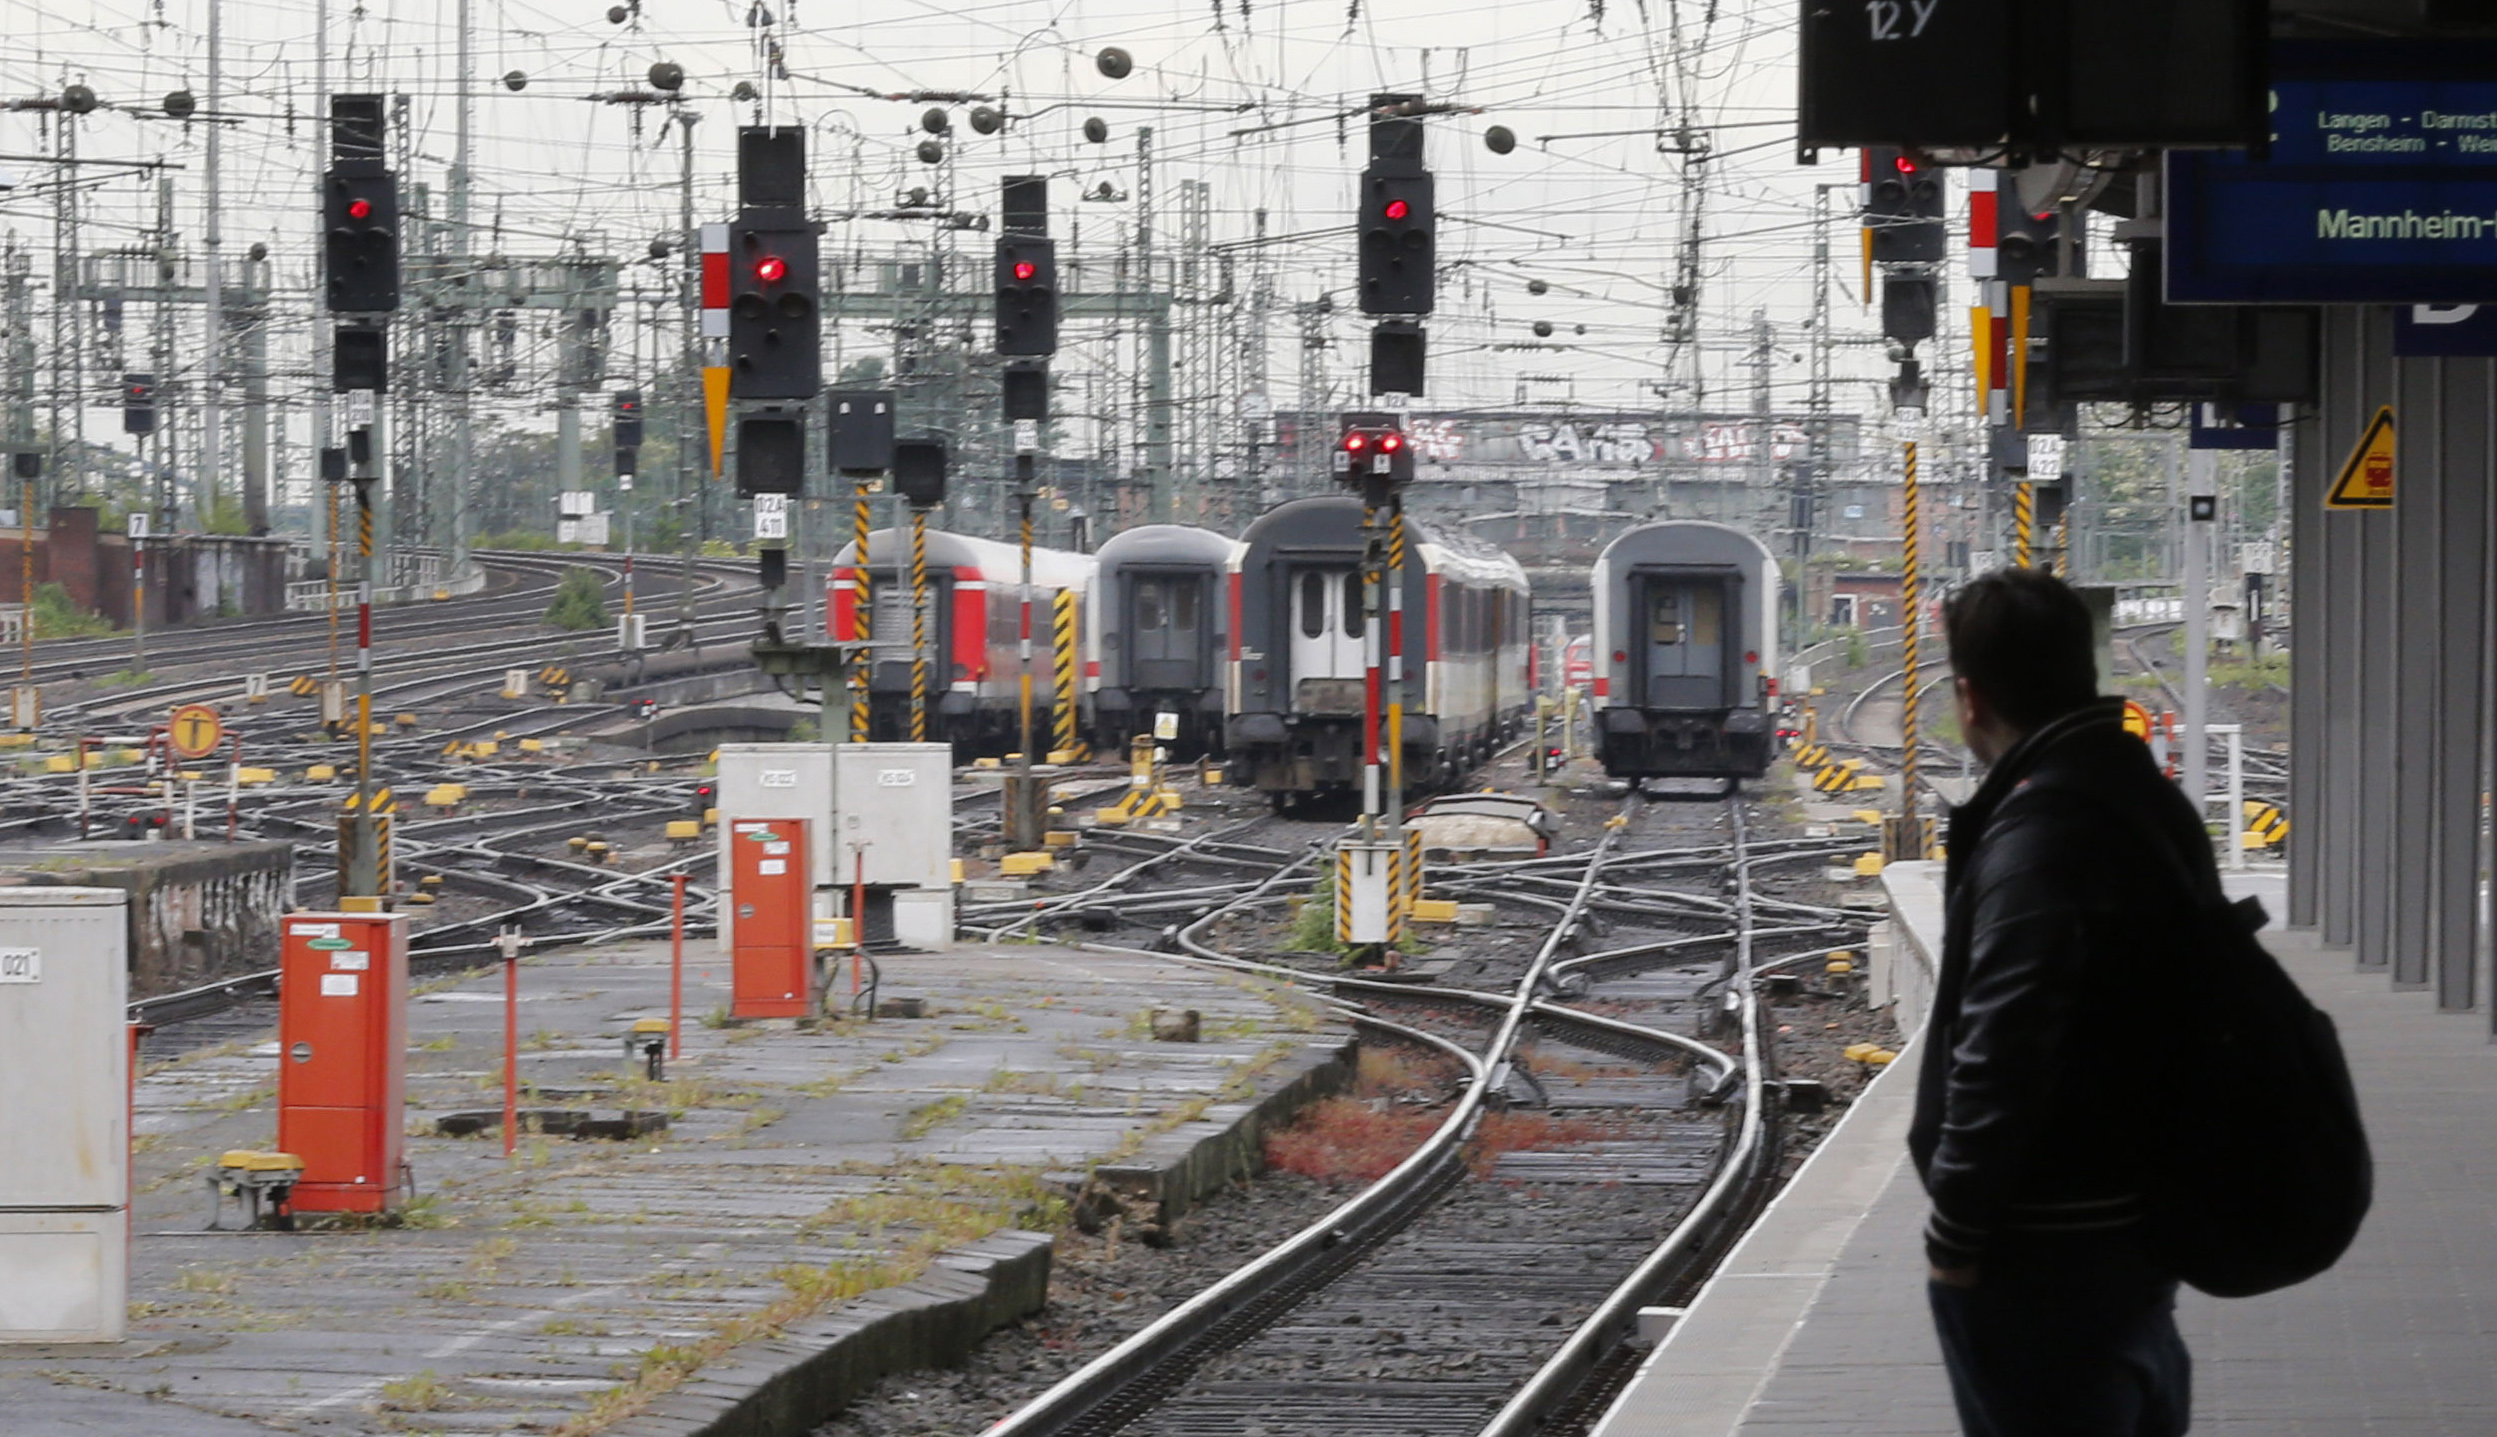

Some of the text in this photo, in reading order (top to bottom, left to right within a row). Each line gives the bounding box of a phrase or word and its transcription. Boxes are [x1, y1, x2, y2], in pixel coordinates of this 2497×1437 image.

[1865, 0, 1902, 40] 12
[2318, 111, 2391, 133] Langen
[2327, 134, 2426, 151] Bensheim
[2317, 209, 2497, 238] Mannheim-
